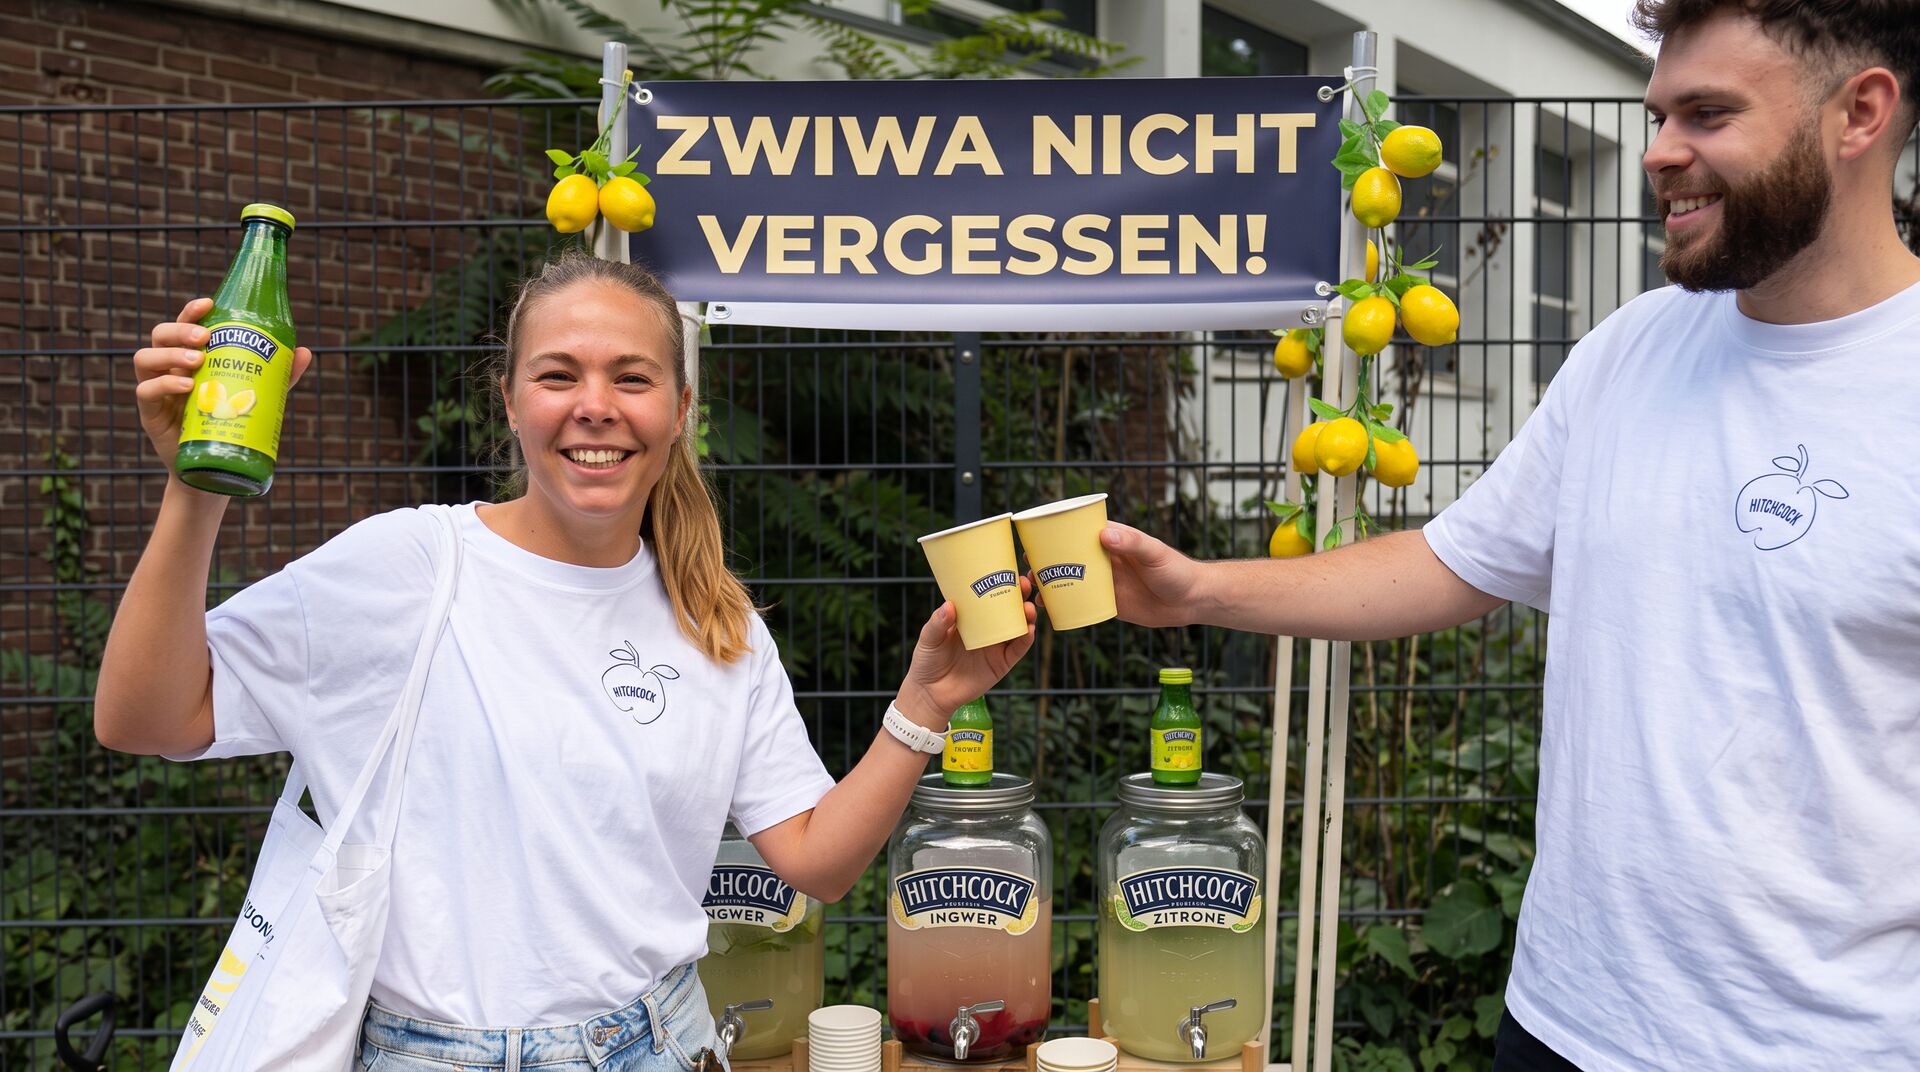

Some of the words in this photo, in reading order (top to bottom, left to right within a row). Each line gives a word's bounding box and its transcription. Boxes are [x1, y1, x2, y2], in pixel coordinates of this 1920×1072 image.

[655, 115, 1005, 176] ZWIWA
[1032, 112, 1317, 176] NICHT
[696, 213, 1268, 276] VERGESSEN!
[208, 328, 275, 357] HITCHCOCK
[208, 357, 263, 377] INGWER
[1749, 498, 1804, 527] HITCHCOCK
[612, 685, 657, 704] HITCHCOCK
[708, 872, 789, 906] CHCOCK
[904, 875, 1024, 909] HITCHCOCK
[1129, 875, 1247, 908] HITCHCOCK
[705, 908, 765, 923] NGWER
[930, 911, 998, 926] INGWER
[1153, 911, 1226, 925] ZITRONE
